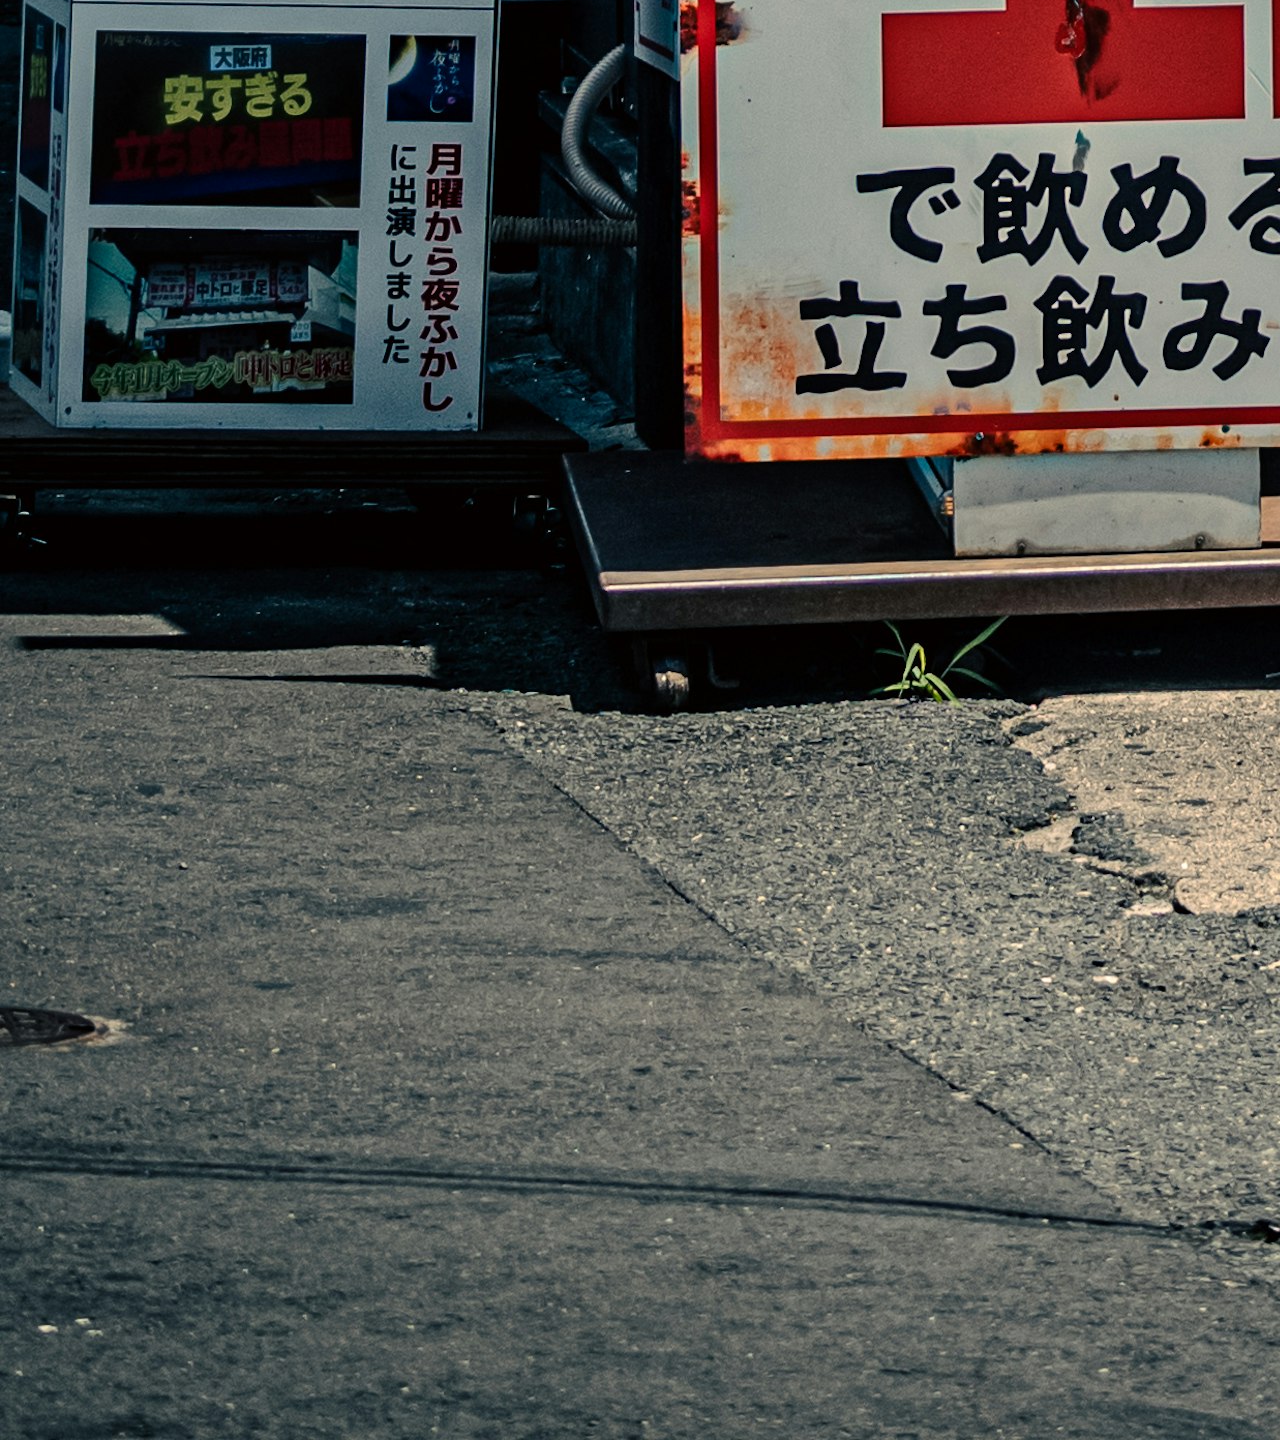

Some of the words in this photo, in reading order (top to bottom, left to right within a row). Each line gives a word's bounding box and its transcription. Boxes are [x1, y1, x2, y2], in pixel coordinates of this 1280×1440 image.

[162, 70, 314, 125] 安すぎる
[214, 46, 269, 69] 大阪府
[381, 144, 418, 365] に出演しました
[419, 142, 465, 413] 月曜から夜ふかし
